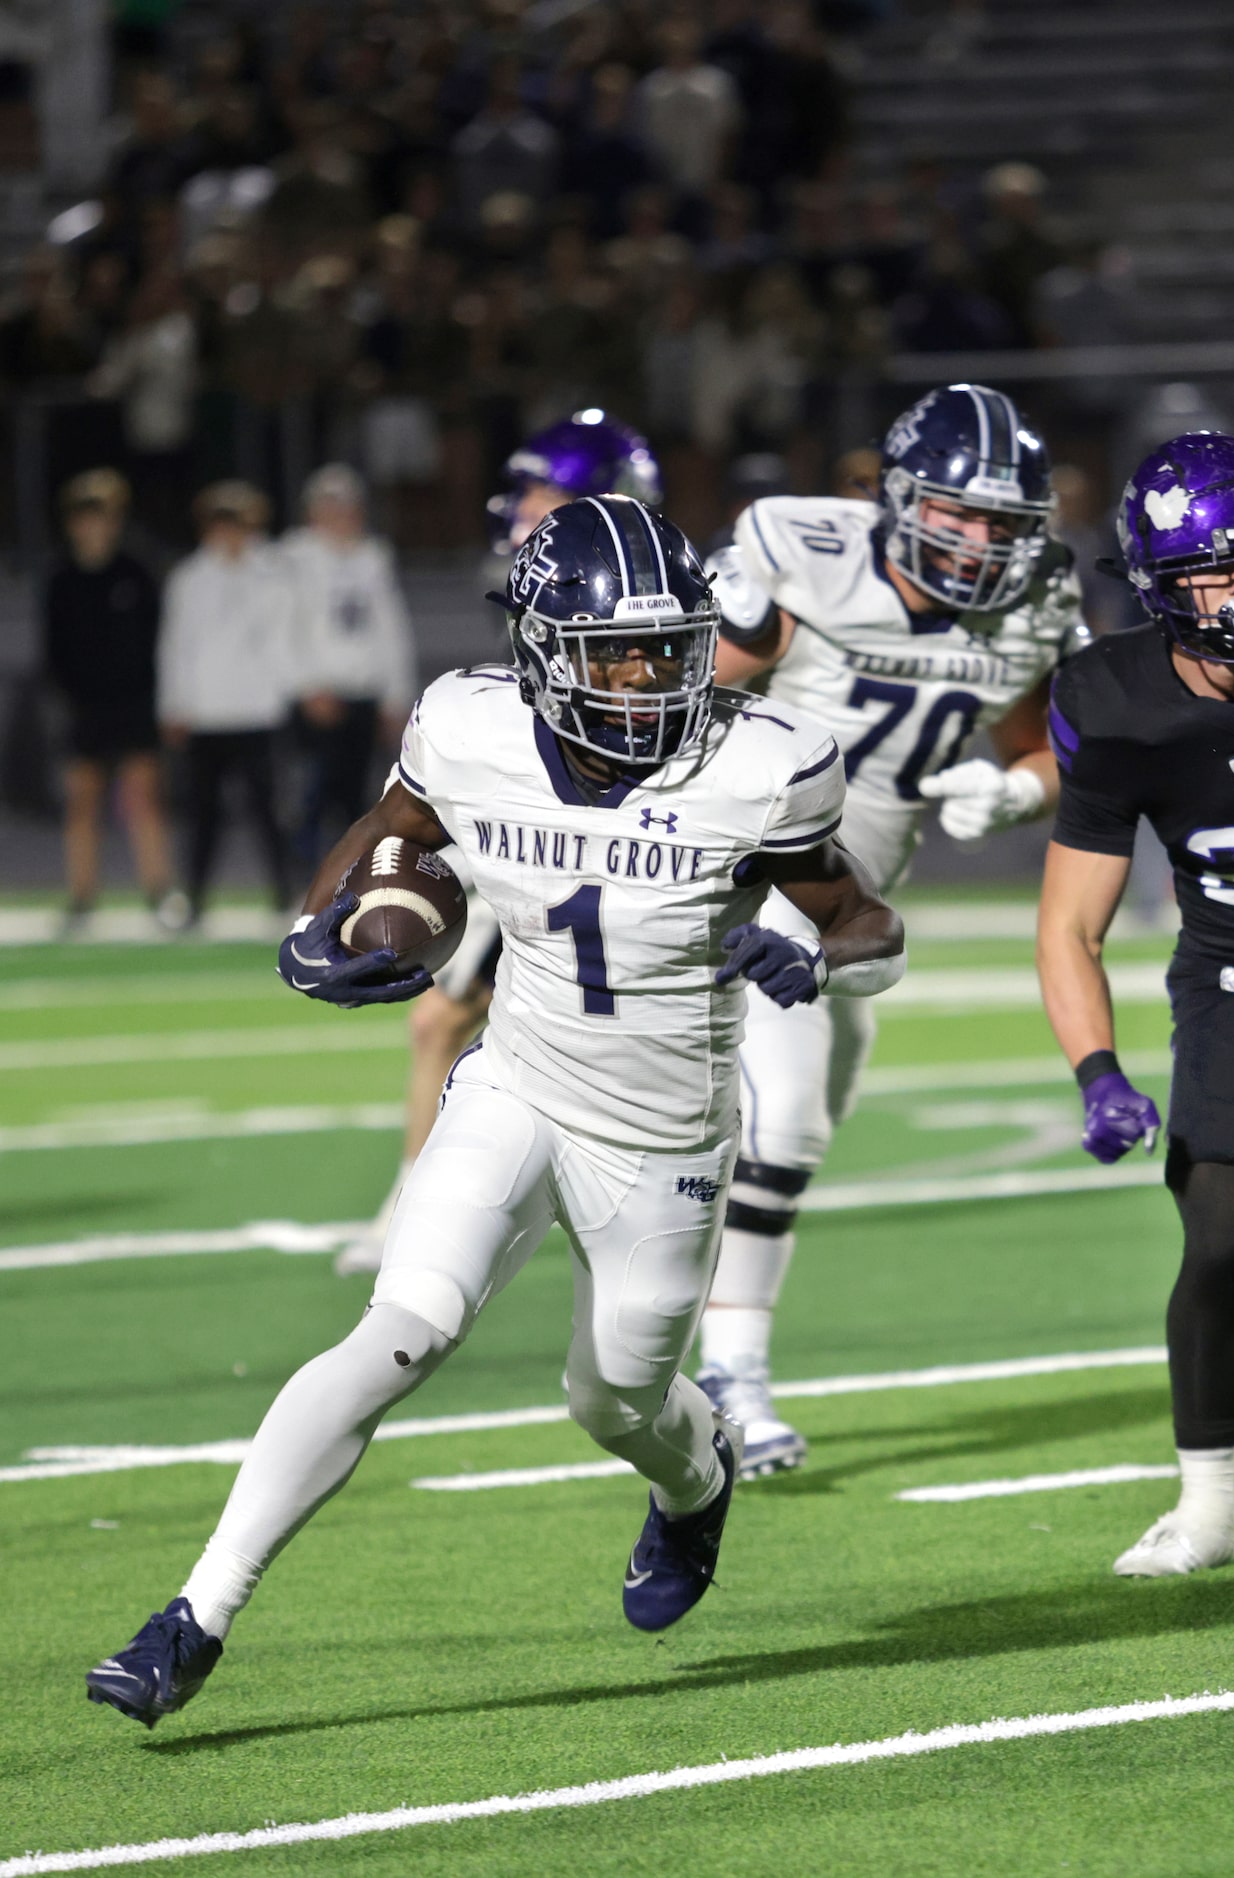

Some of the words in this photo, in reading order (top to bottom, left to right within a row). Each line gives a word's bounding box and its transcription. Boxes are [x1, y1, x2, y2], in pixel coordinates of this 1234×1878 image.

[789, 519, 845, 556] 70
[627, 600, 644, 610] THE
[647, 599, 676, 609] GROVE
[844, 676, 983, 801] 70
[473, 818, 587, 871] WALNUT
[607, 839, 703, 881] GROVE
[544, 881, 618, 1018] 1
